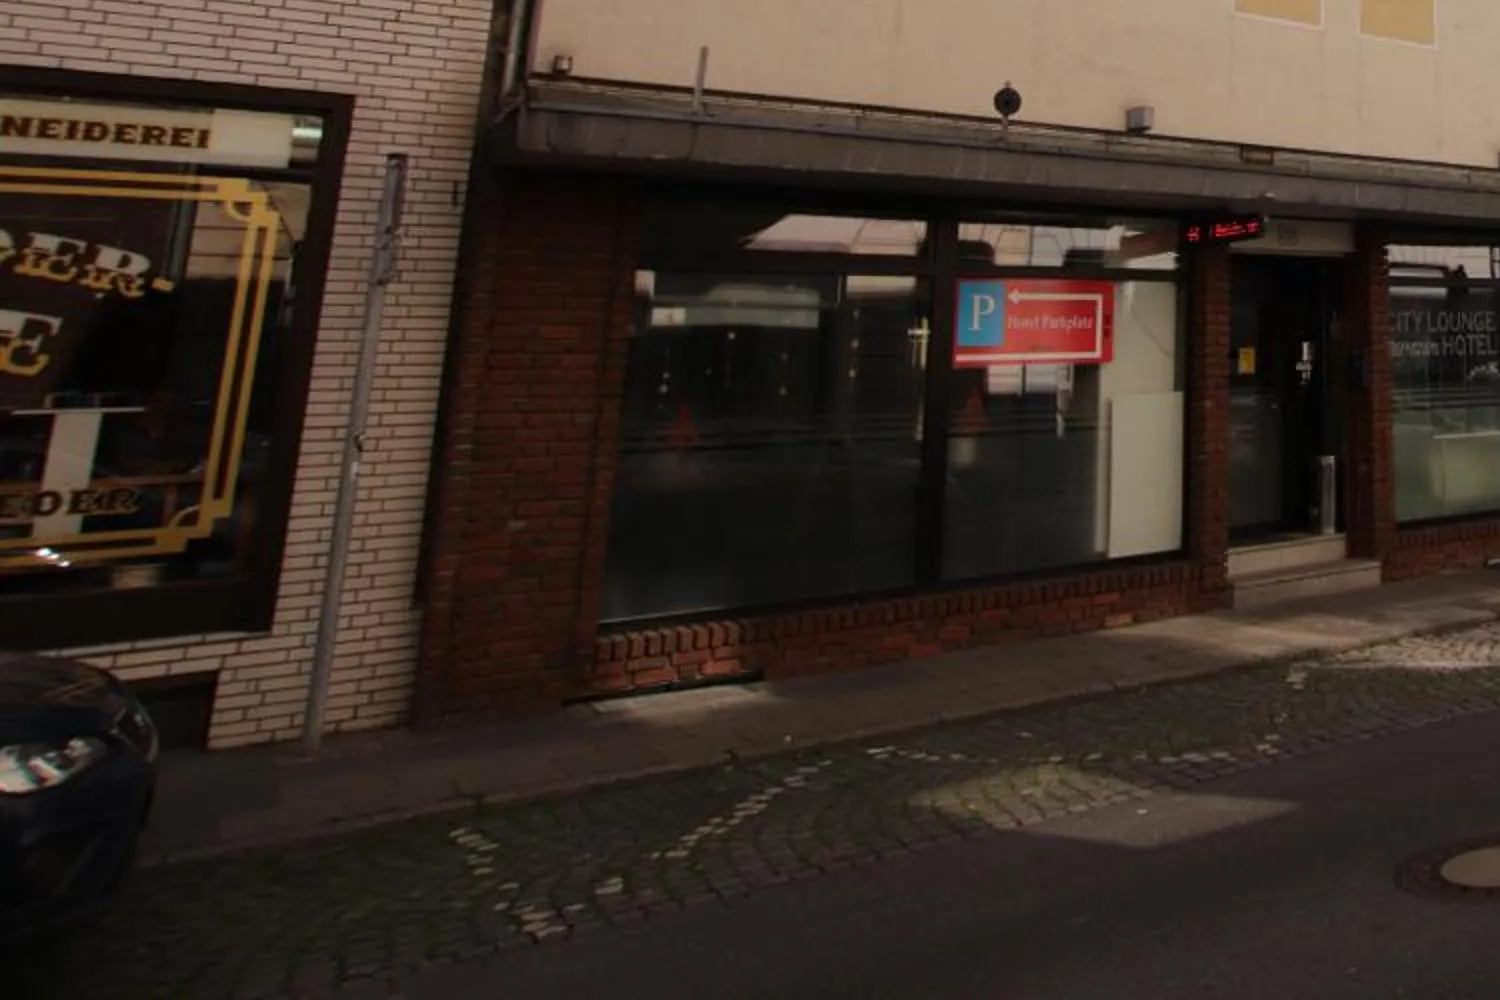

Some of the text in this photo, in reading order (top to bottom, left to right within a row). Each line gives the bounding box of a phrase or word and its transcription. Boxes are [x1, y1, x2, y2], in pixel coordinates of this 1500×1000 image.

[968, 294, 995, 331] P
[1425, 311, 1497, 332] LOUNGE
[1440, 333, 1498, 357] HOTEL
